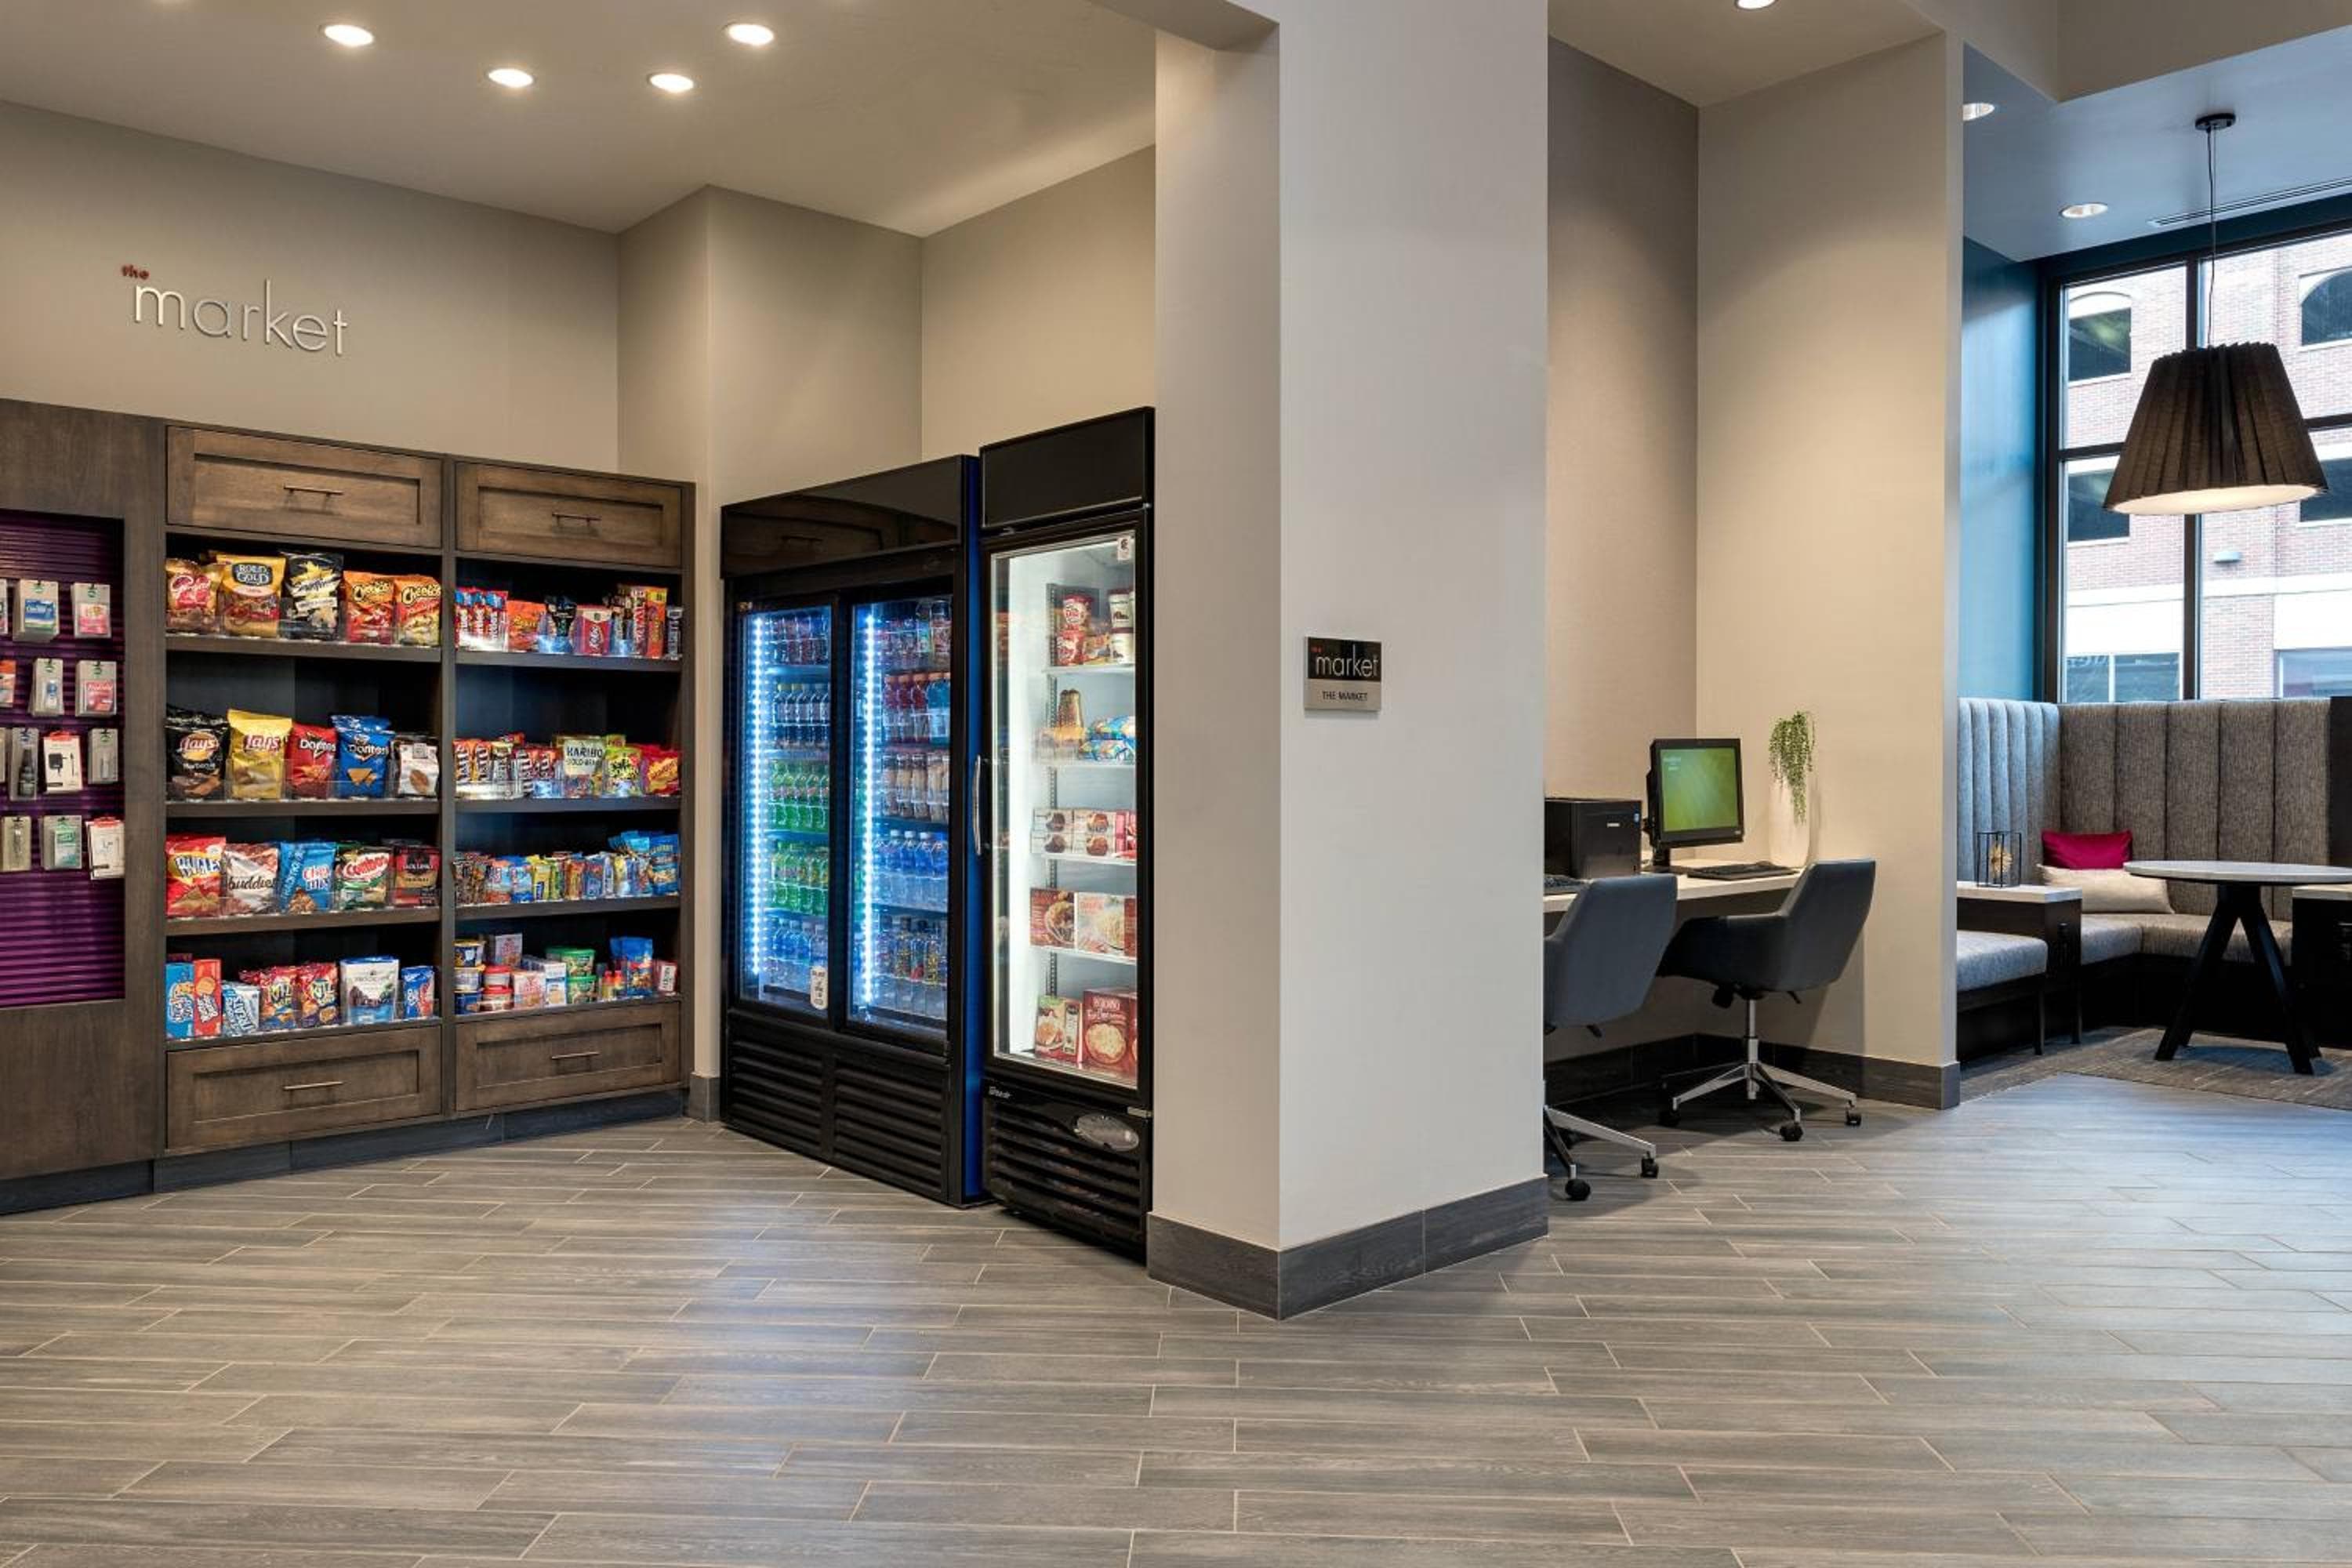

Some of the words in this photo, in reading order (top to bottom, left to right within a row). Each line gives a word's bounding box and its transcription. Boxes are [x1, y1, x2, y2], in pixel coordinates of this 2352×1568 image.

[122, 265, 150, 281] the
[134, 278, 348, 355] market
[237, 572, 269, 583] GOLD
[402, 584, 441, 605] Cheetos
[1316, 644, 1378, 677] market
[1323, 691, 1336, 700] THE
[567, 746, 603, 758] HARIBO
